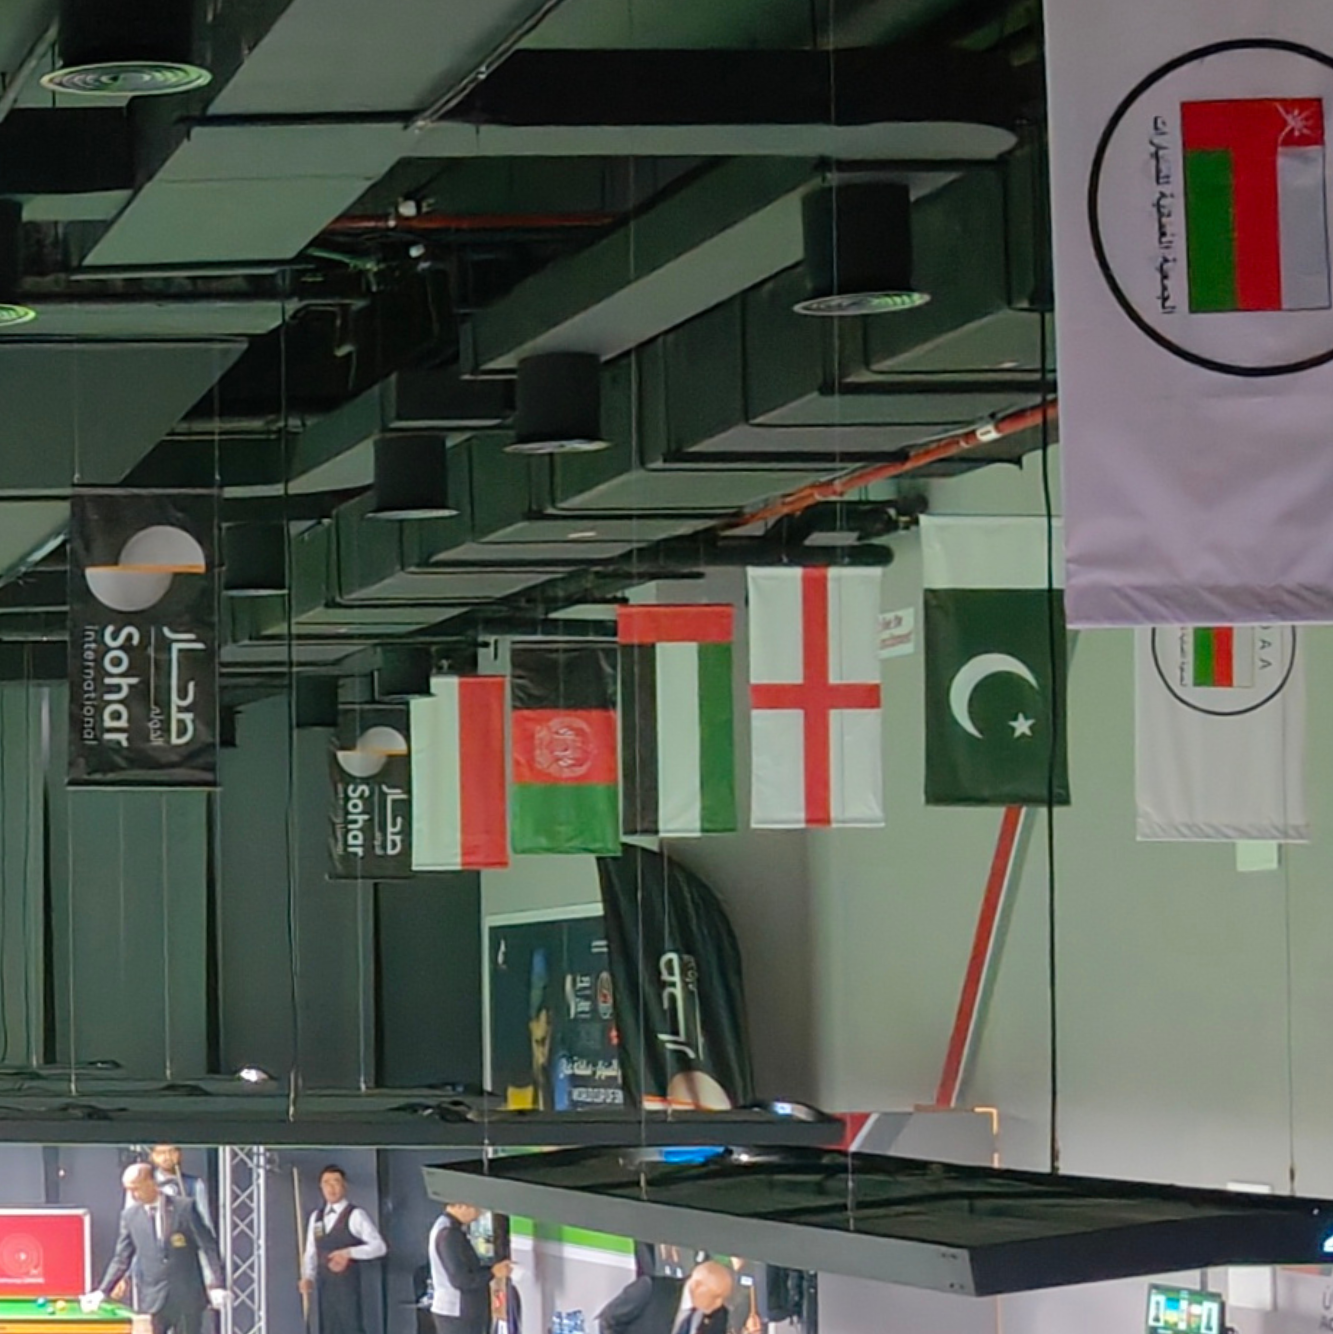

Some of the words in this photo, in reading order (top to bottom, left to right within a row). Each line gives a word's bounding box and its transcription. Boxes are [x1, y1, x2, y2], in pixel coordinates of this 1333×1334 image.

[103, 623, 141, 748] Sohar
[162, 625, 206, 746] صحار
[346, 783, 370, 858] Sohar
[381, 783, 409, 856] صحار
[657, 951, 696, 1060] صحار
